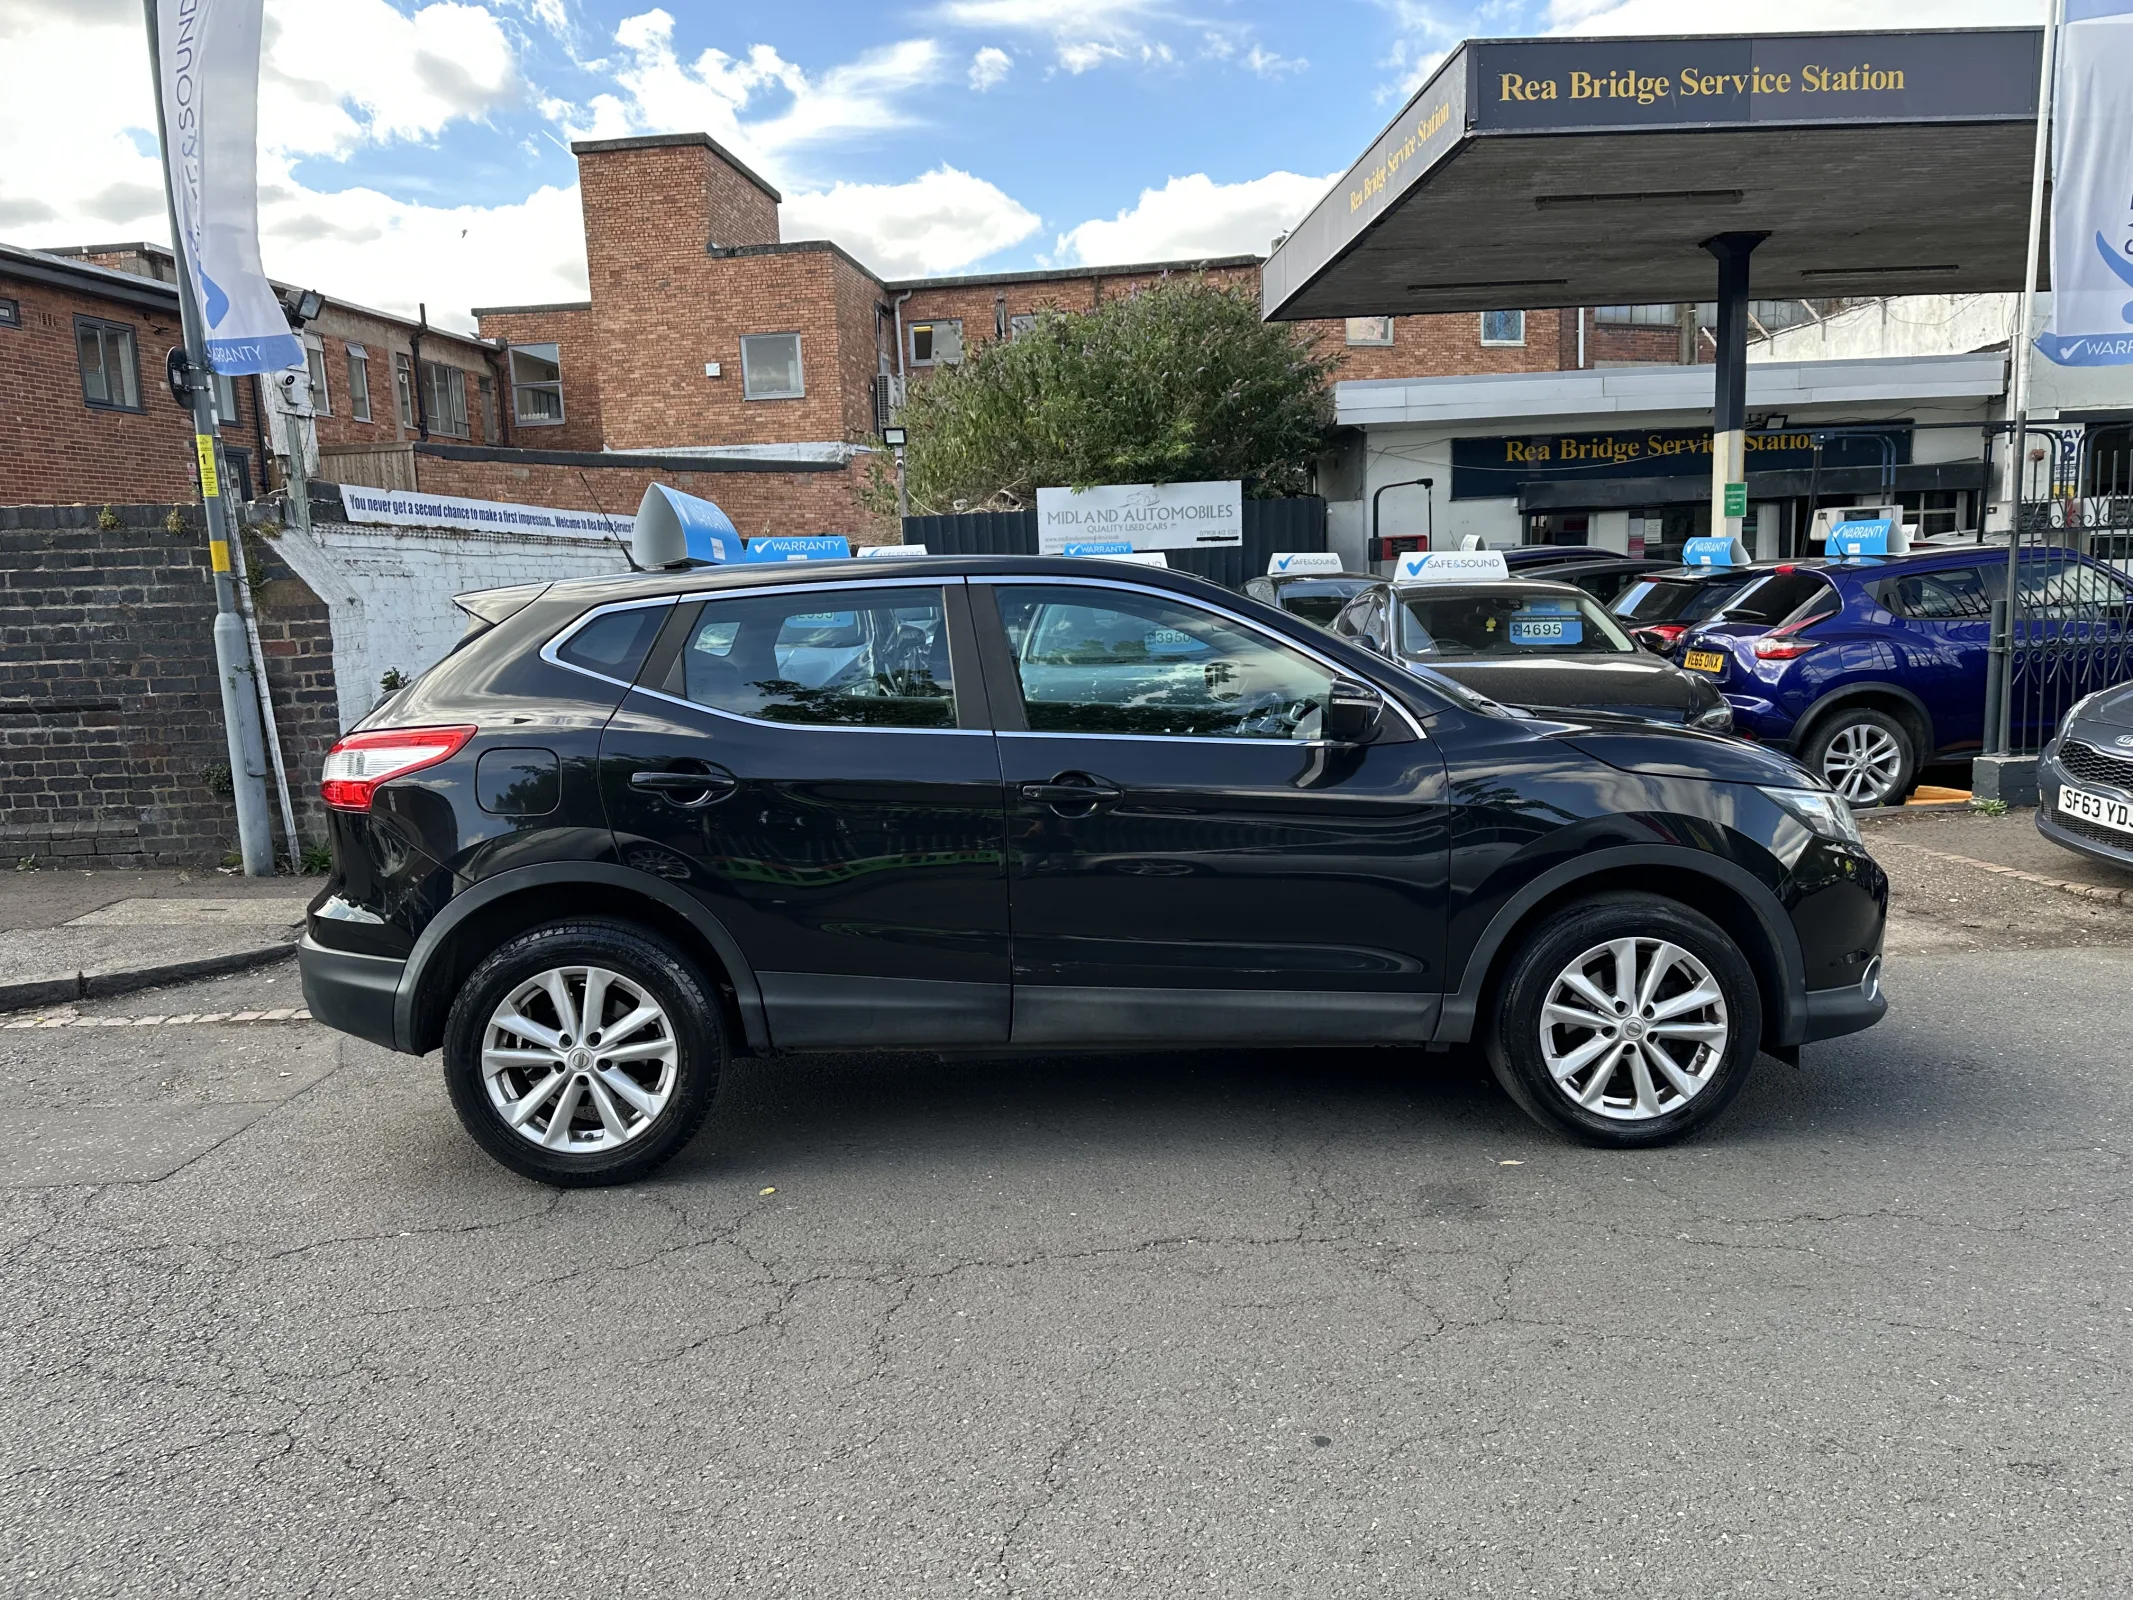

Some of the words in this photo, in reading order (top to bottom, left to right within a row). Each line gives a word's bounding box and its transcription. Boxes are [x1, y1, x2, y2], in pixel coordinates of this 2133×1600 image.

[1499, 73, 1558, 101] Rea
[1569, 70, 1670, 105] Bridge
[1680, 66, 1792, 97] Service
[1801, 63, 1906, 93] Station
[1350, 190, 1363, 214] Rea
[1364, 166, 1386, 200] Bridge
[1387, 136, 1416, 177] Service
[1417, 102, 1449, 148] Station
[1505, 440, 1551, 462] Rea
[1559, 437, 1640, 464] Bridge
[1647, 433, 1714, 456] Servi
[200, 453, 207, 465] 1
[349, 494, 366, 511] You
[367, 498, 391, 513] never
[393, 500, 406, 515] get
[408, 503, 414, 514] a
[415, 503, 442, 518] second
[443, 504, 470, 519] chance
[471, 509, 478, 520] to
[479, 508, 498, 522] make
[498, 512, 503, 523] a
[503, 510, 519, 524] first
[554, 515, 581, 530] Welcome
[581, 517, 588, 531] to
[587, 518, 598, 531] Rea
[597, 519, 614, 533] Bridge
[614, 520, 632, 534] Service
[1047, 509, 1119, 525] MIDLAND
[1123, 504, 1233, 522] AUTOMOBILES
[1087, 524, 1123, 534] QUALITY
[1125, 523, 1144, 532] USED
[1146, 522, 1168, 531] CARS
[1842, 525, 1886, 539] WARRANTY
[771, 540, 841, 551] WARRANTY
[1081, 544, 1129, 553] WARRANTY
[1695, 541, 1730, 553] WARRANTY
[1291, 557, 1338, 566] SAFE&SOUND
[1427, 559, 1500, 569] SAFE&SOUND
[1512, 623, 1561, 636] £4695
[2065, 789, 2101, 818] SF63
